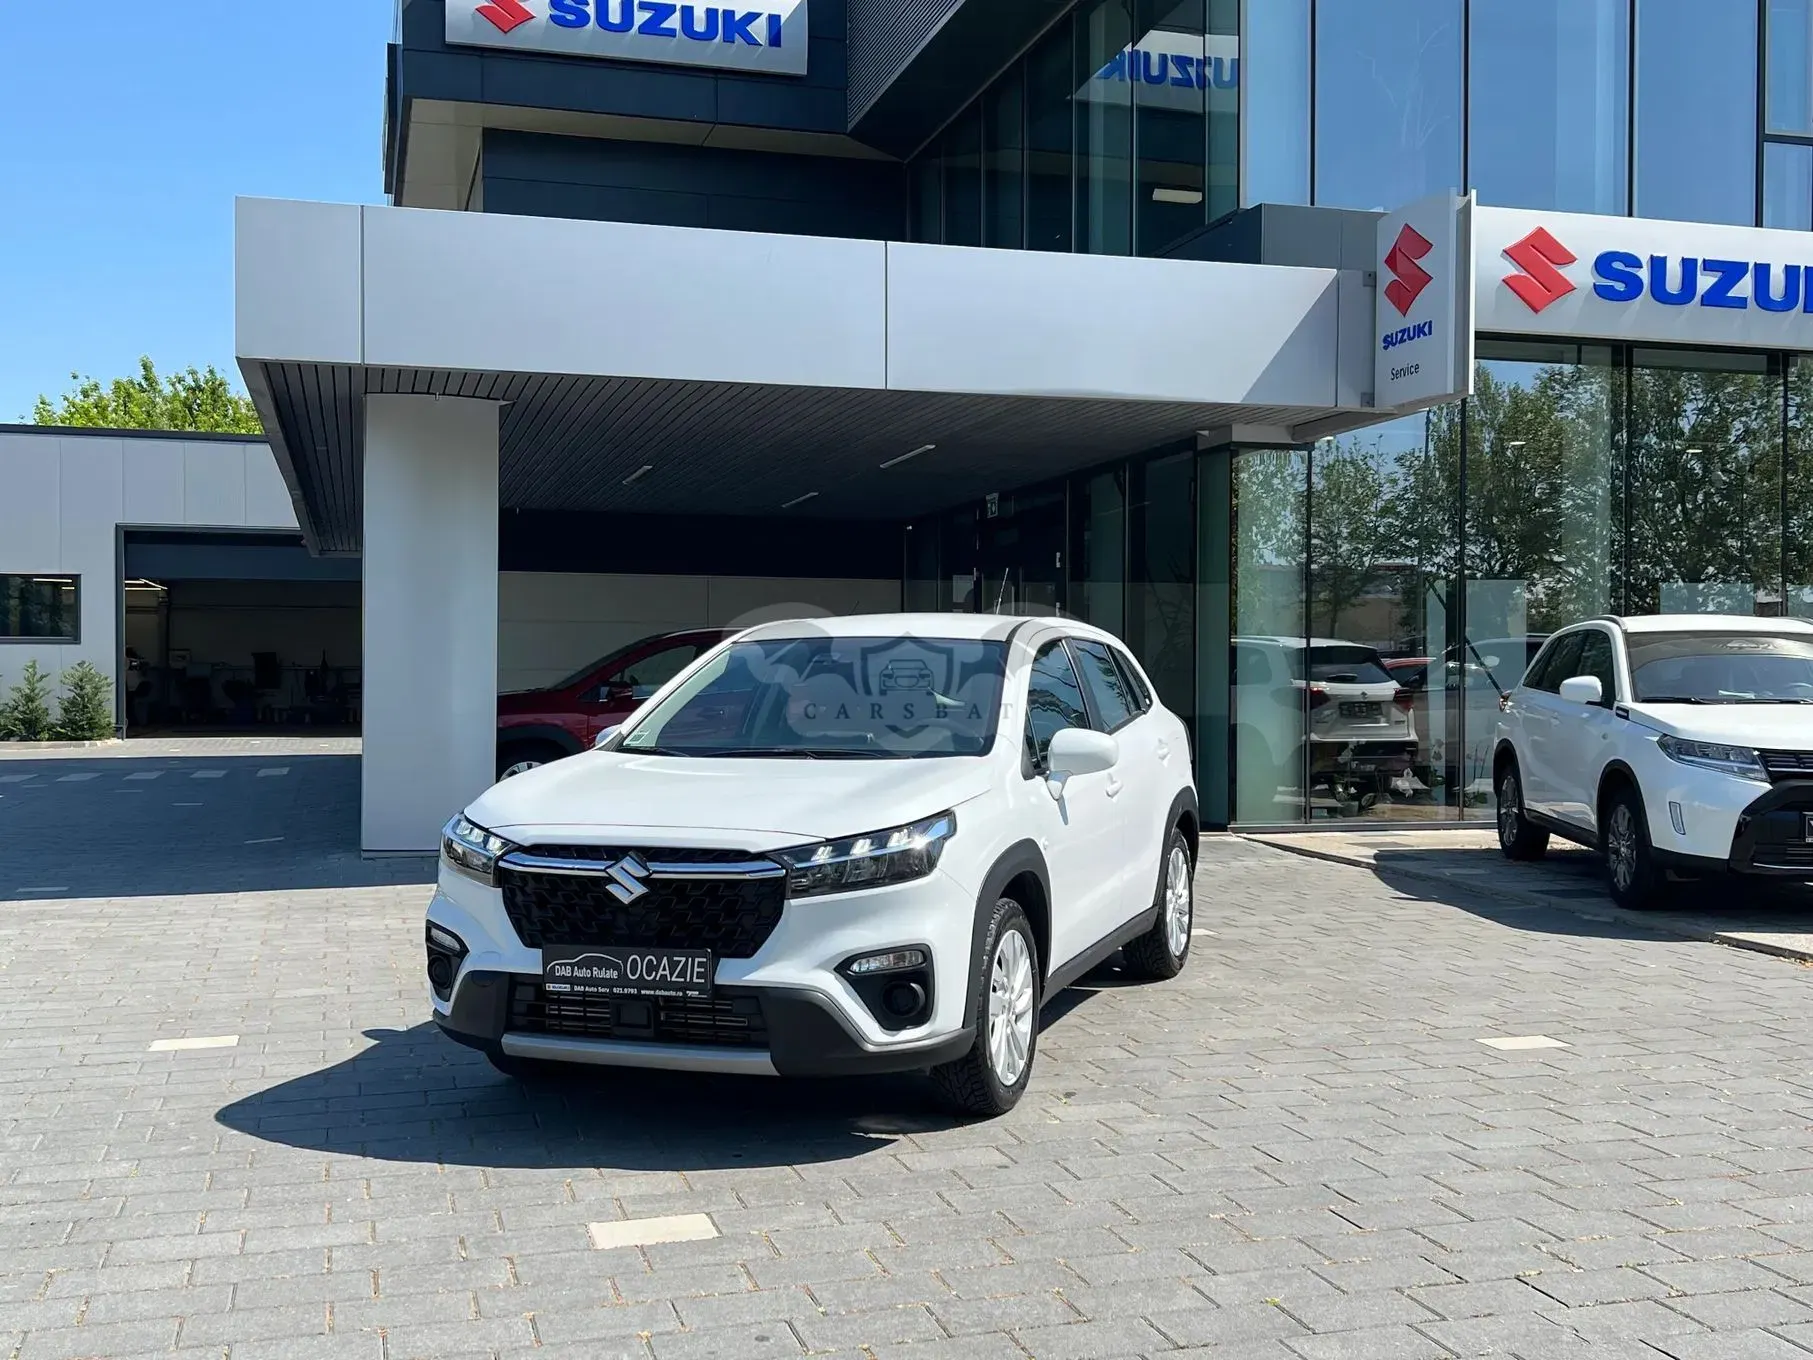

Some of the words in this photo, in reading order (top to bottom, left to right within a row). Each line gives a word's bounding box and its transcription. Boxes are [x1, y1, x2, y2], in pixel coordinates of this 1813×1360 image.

[549, 0, 782, 48] SUZUKI
[1382, 319, 1433, 351] SUZUKI
[1390, 363, 1420, 381] Service
[555, 965, 572, 977] DAB
[573, 966, 591, 978] Auto
[592, 967, 618, 979] Rulate
[626, 954, 707, 983] OCAZIE
